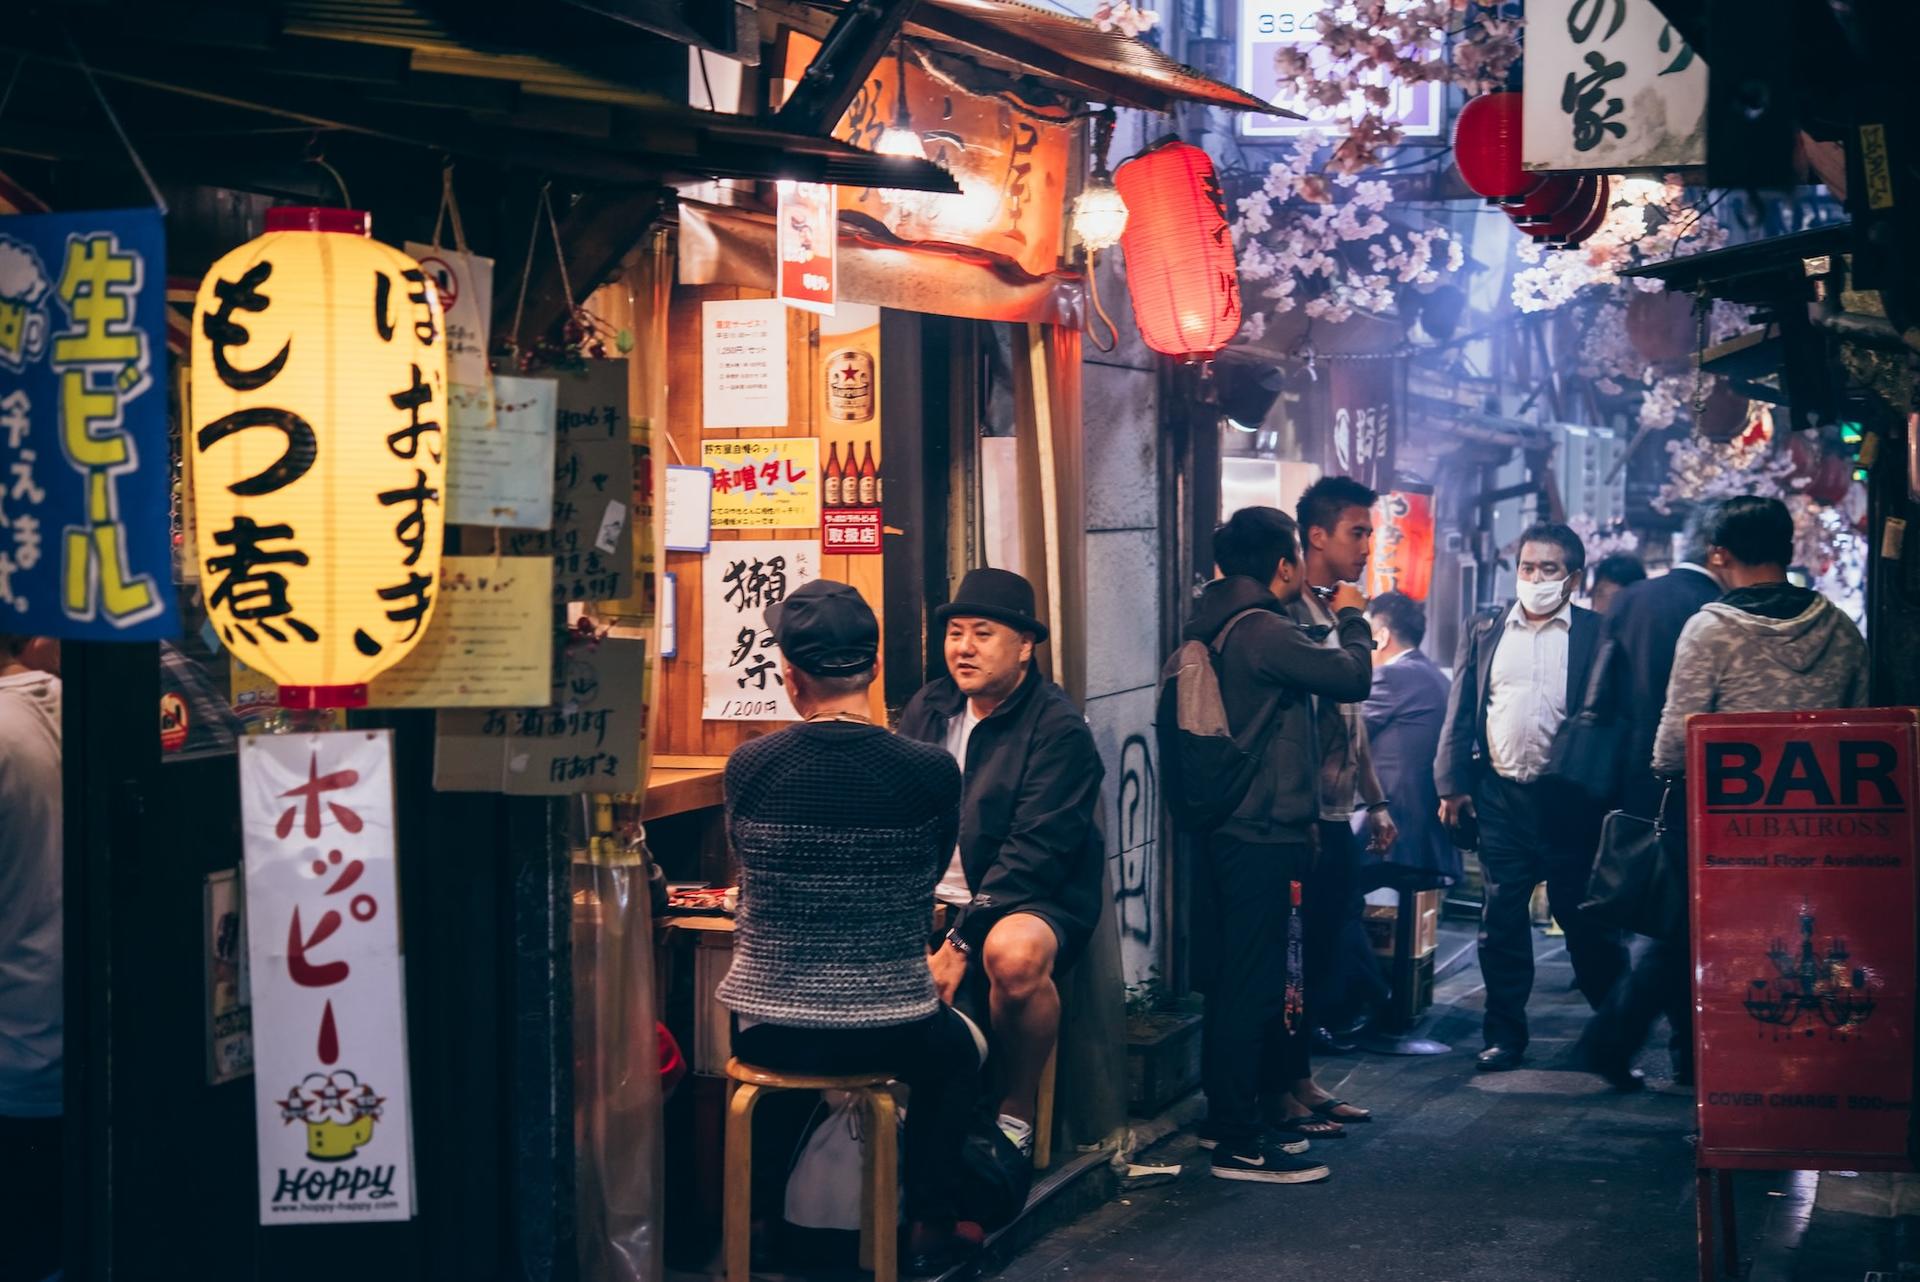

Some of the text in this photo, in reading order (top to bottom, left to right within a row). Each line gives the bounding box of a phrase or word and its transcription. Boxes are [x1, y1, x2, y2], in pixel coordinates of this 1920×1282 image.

[52, 235, 161, 625] 生ビール
[199, 260, 319, 645] もつ煮
[711, 459, 807, 495] 味噌ダレ
[828, 527, 876, 544] 取扱店
[1705, 741, 1904, 805] BAR
[1725, 816, 1891, 837] ALBATROSS
[1705, 854, 1900, 868] Second Floor Available
[275, 750, 377, 1065] ホッピー
[1708, 1092, 1763, 1106] COVER
[1768, 1093, 1839, 1109] CHARGE
